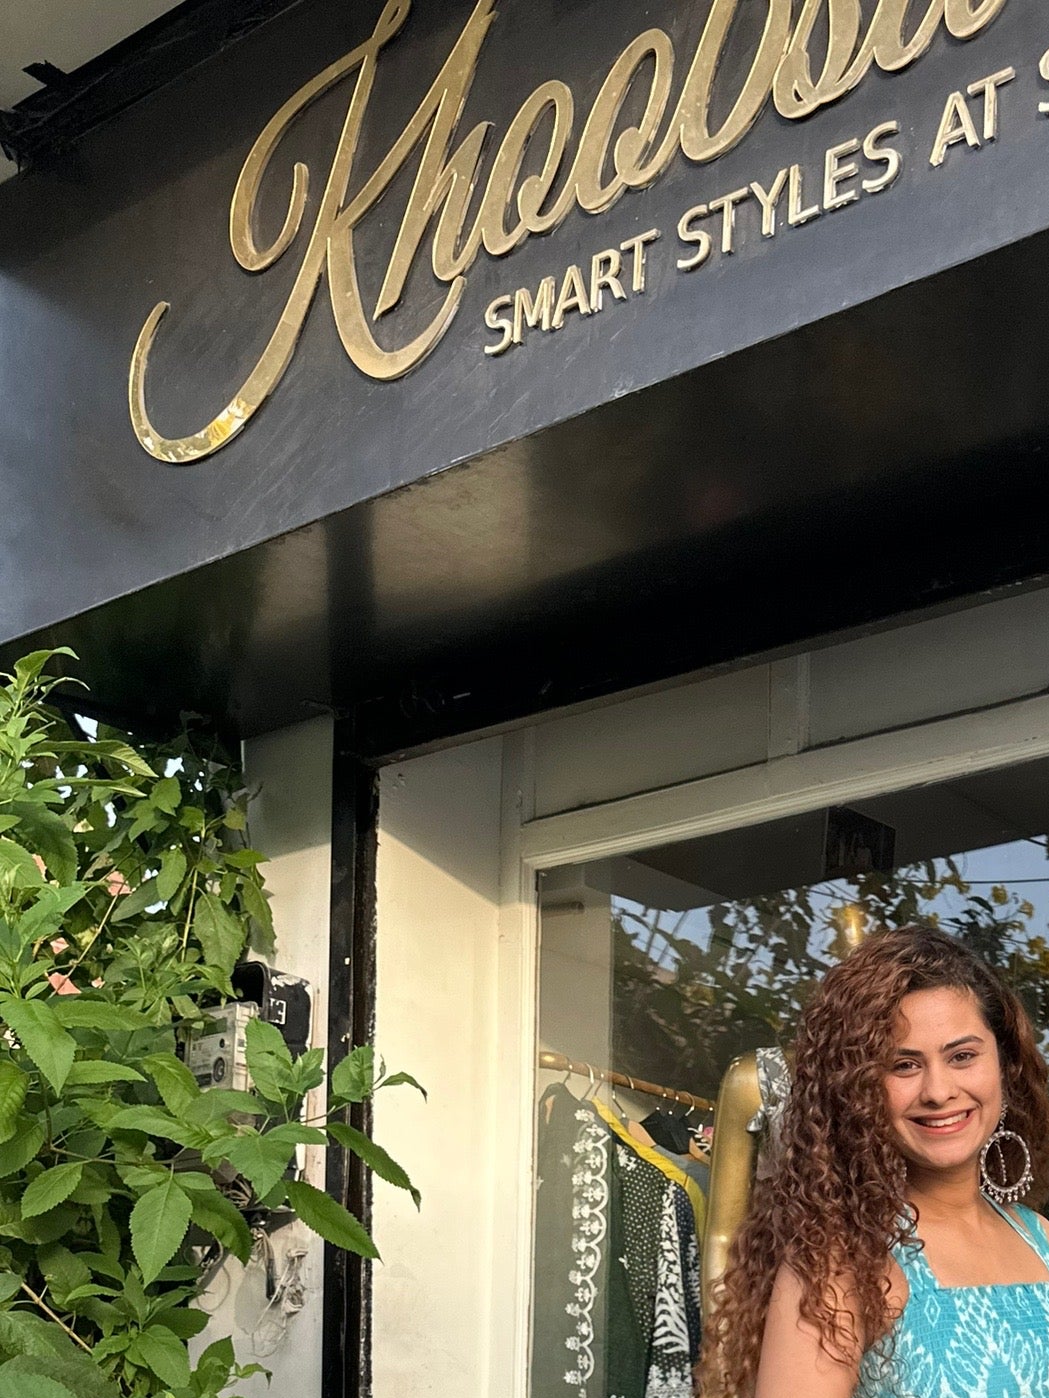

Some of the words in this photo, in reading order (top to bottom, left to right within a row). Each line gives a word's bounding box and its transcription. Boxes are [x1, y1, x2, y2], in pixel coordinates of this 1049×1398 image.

[483, 227, 661, 356] SMART
[676, 120, 903, 272] STYLES
[929, 66, 1016, 169] AT
